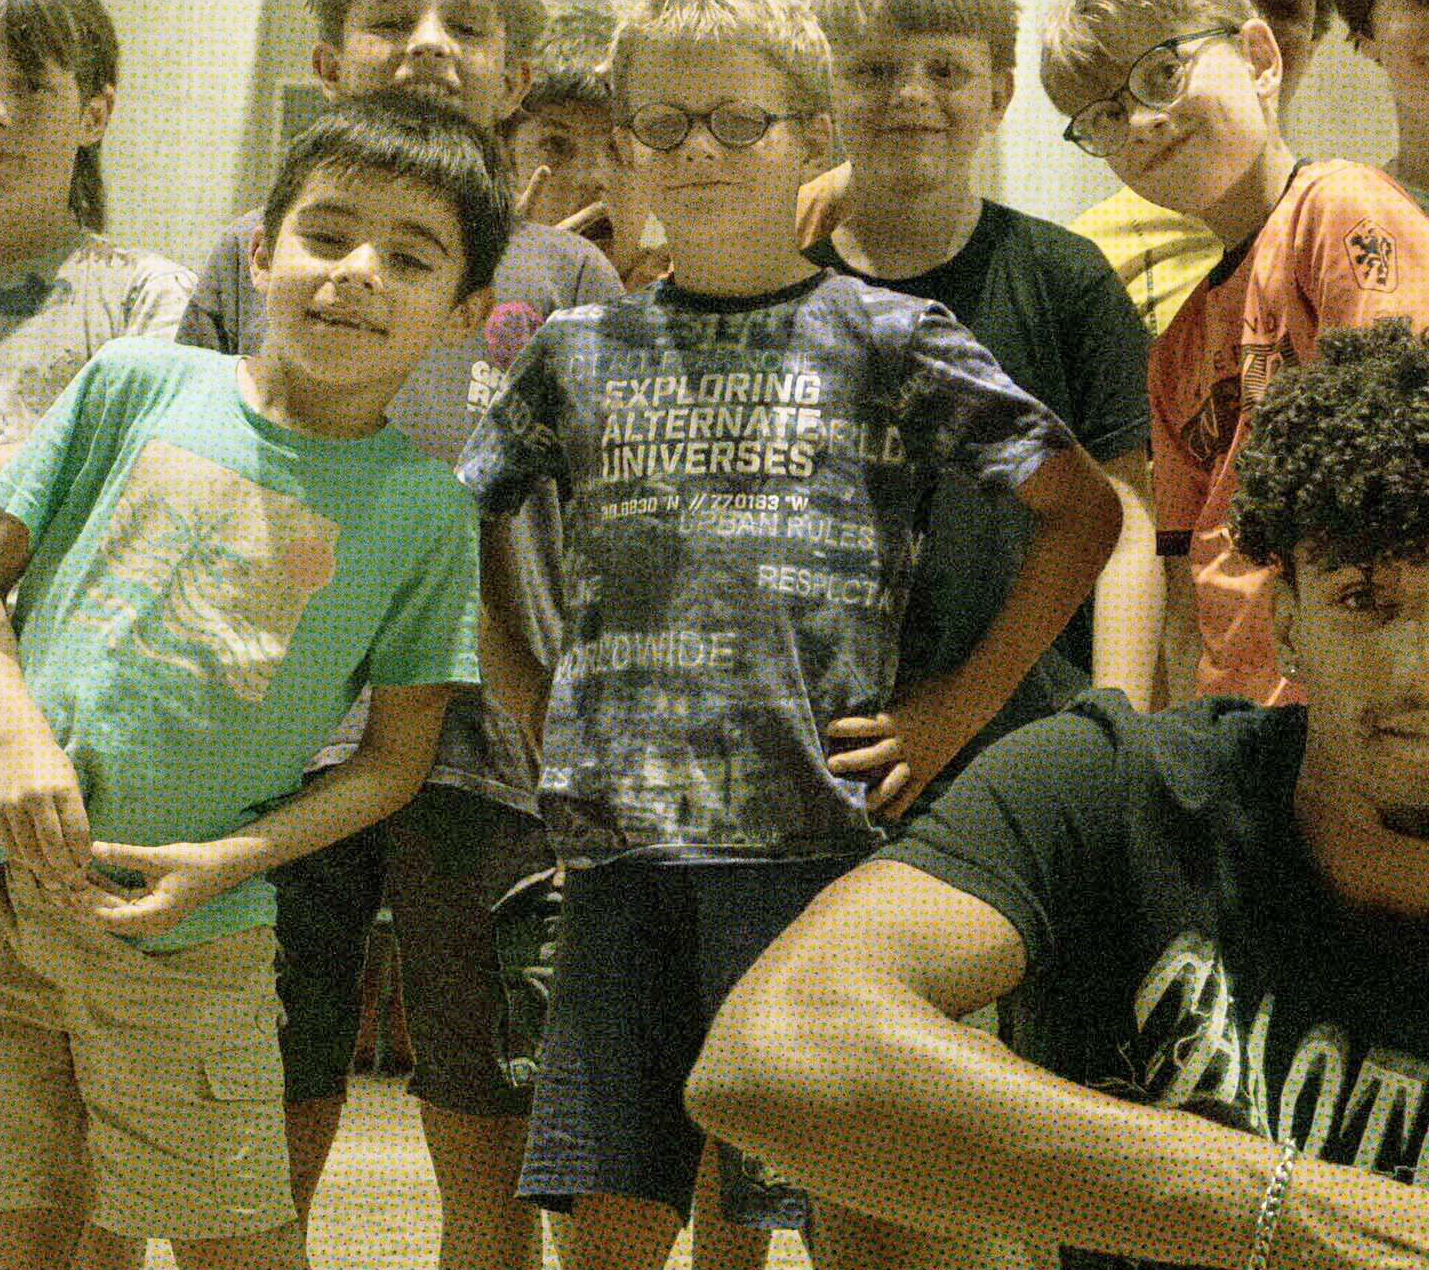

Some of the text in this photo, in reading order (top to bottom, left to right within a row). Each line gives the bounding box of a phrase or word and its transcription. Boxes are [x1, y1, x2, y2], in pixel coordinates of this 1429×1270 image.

[604, 373, 821, 409] EXPLORING
[602, 405, 821, 446] ALTERNATE
[602, 441, 814, 483] UNIVERSES
[786, 514, 875, 551] RULES
[757, 564, 877, 608] RESPECT
